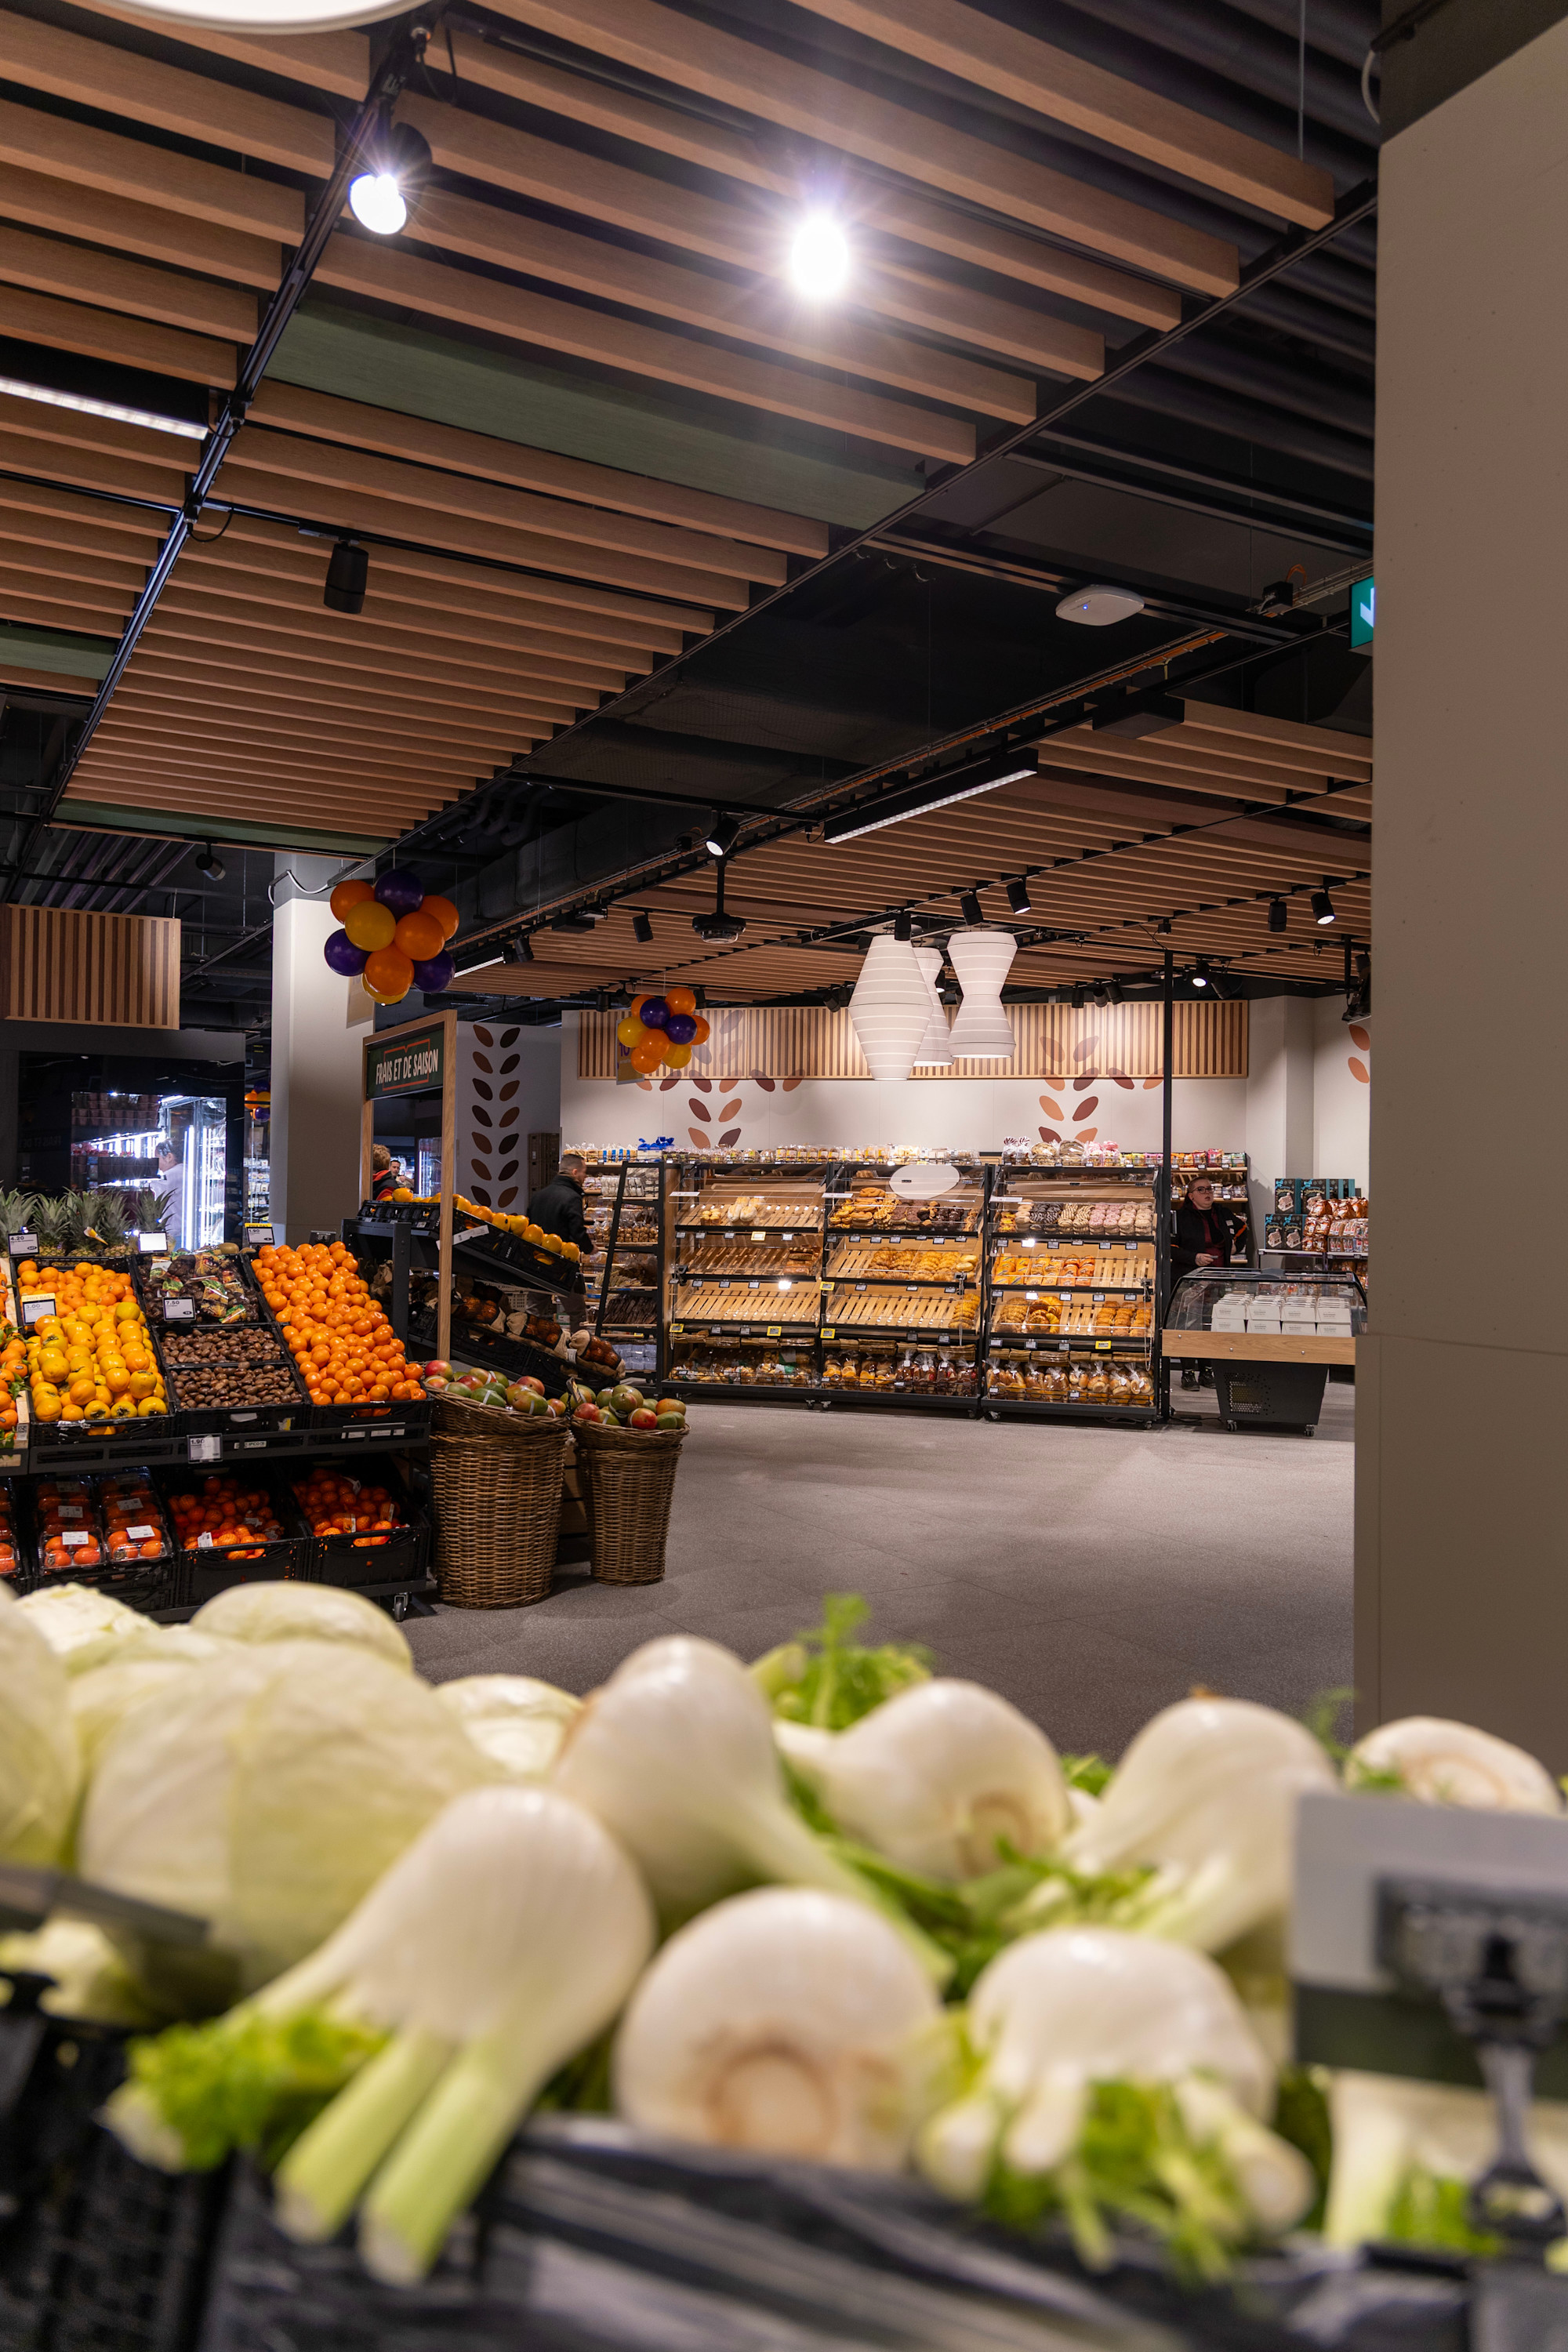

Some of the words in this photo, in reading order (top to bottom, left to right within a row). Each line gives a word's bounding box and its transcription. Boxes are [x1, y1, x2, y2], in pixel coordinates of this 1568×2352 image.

[376, 1061, 392, 1085] FRAIS
[394, 1058, 402, 1081] ET
[403, 1055, 412, 1078] DE
[413, 1049, 438, 1076] SAISON
